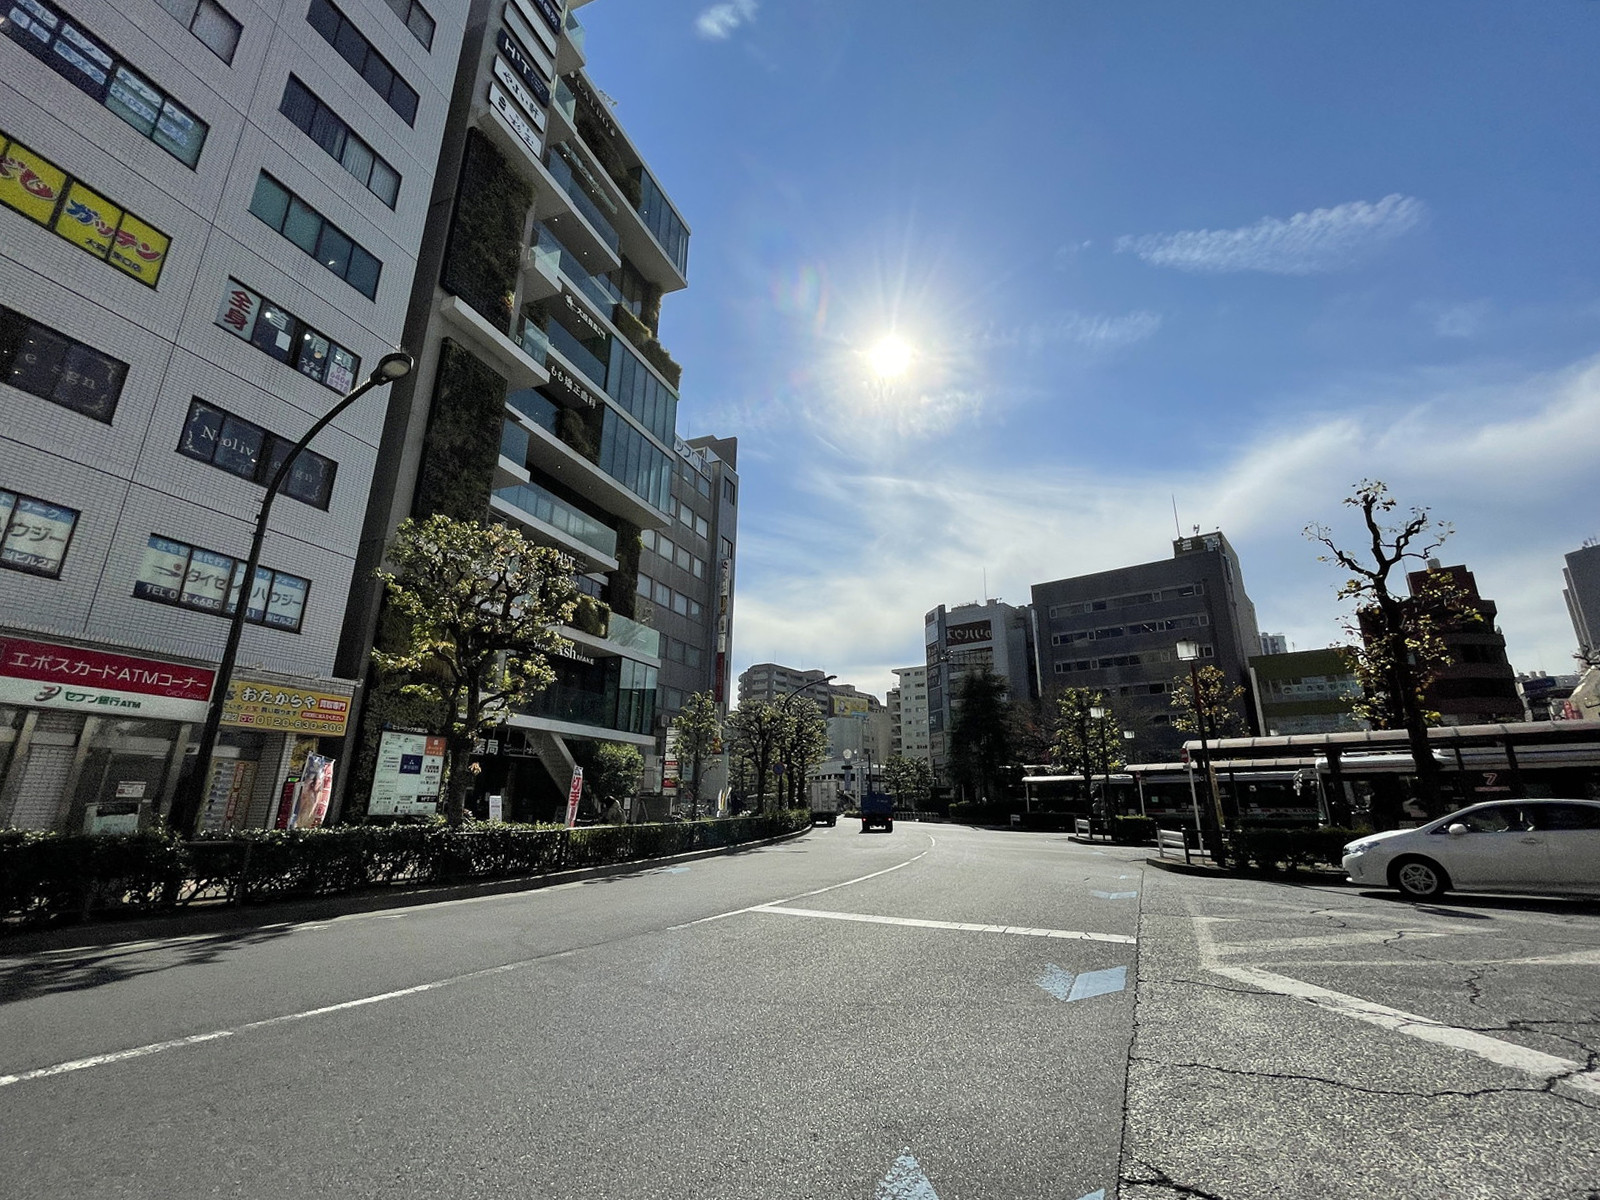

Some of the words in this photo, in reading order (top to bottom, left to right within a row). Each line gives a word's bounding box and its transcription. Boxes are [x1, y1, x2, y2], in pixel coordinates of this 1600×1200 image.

[502, 70, 540, 120] やよい軒
[227, 289, 254, 331] 全身
[146, 584, 167, 598] TEL
[9, 652, 207, 690] エポスカードATMコーナー
[65, 690, 141, 709] セブン銀行ATM
[242, 686, 317, 710] おたからや
